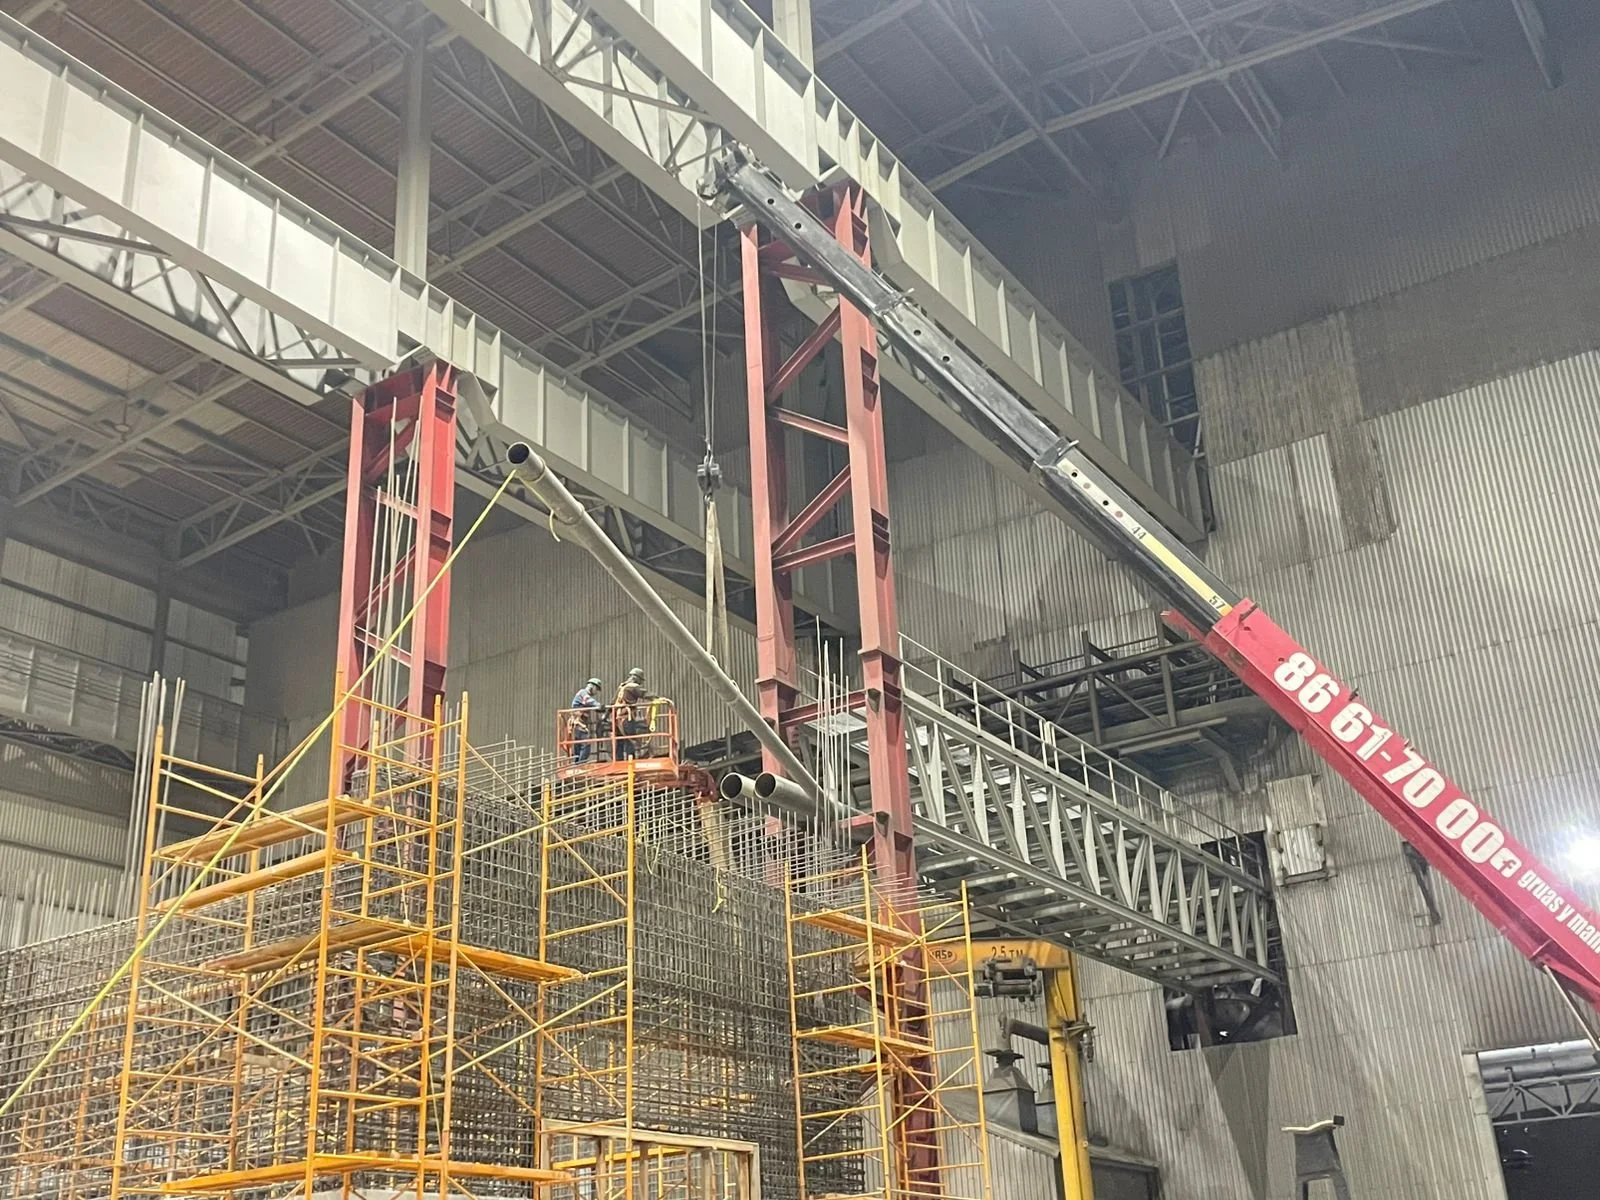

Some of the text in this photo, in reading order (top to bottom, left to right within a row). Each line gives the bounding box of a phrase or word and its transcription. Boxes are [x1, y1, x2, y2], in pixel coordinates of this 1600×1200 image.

[1132, 526, 1147, 540] 44
[1209, 595, 1226, 609] 57
[1274, 652, 1505, 863] 86 61-70 00
[1517, 869, 1564, 912] gruas
[1555, 904, 1575, 922] y
